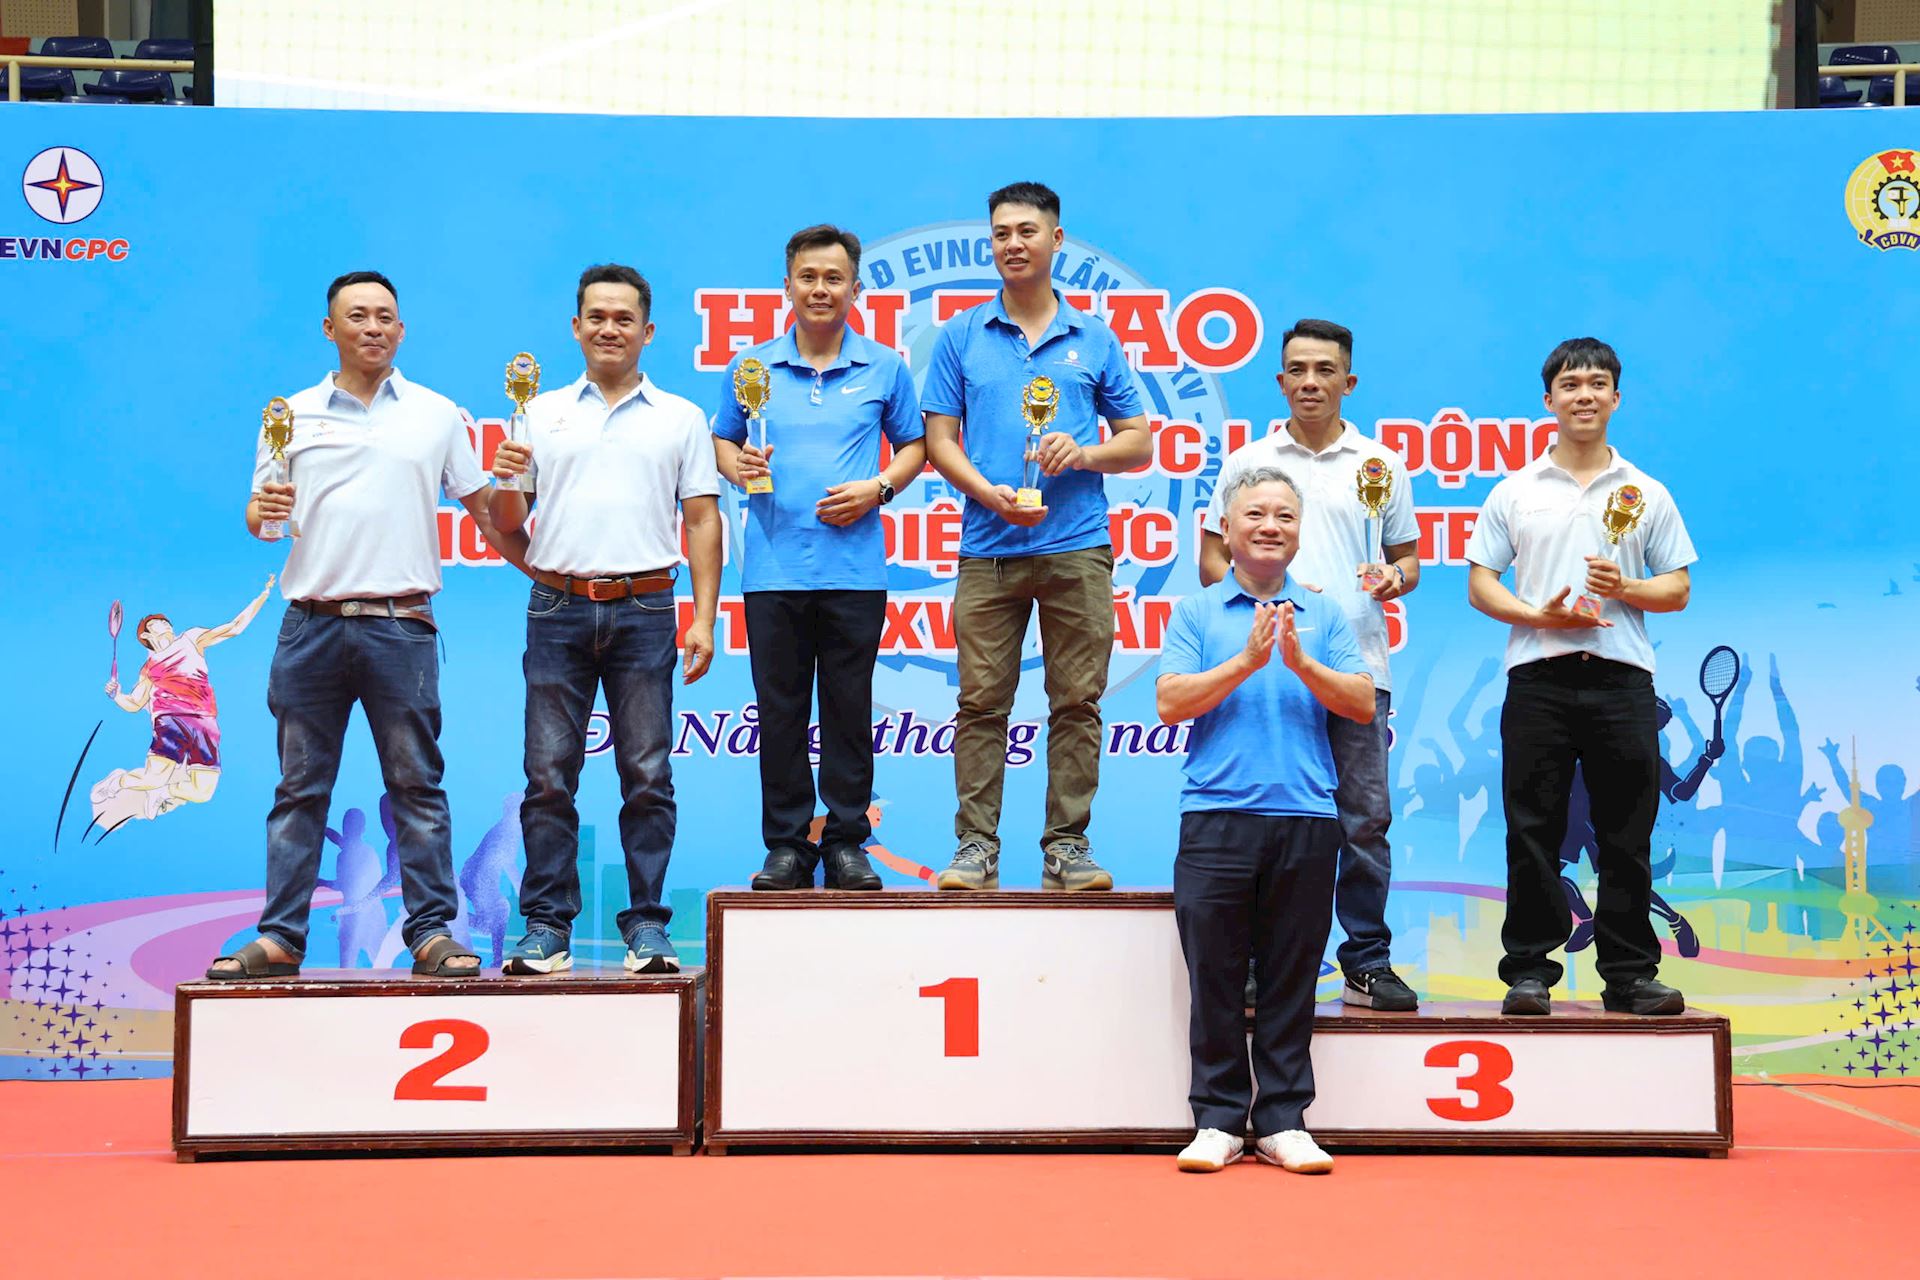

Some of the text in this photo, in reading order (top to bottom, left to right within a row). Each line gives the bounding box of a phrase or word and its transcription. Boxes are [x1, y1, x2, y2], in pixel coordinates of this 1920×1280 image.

[0, 238, 129, 260] EVNCPC
[902, 237, 993, 278] EVNC
[1880, 233, 1919, 249] CĐVN
[700, 294, 905, 366] HI
[919, 977, 979, 1057] 1
[393, 1018, 490, 1102] 2
[1424, 1040, 1514, 1122] 3
